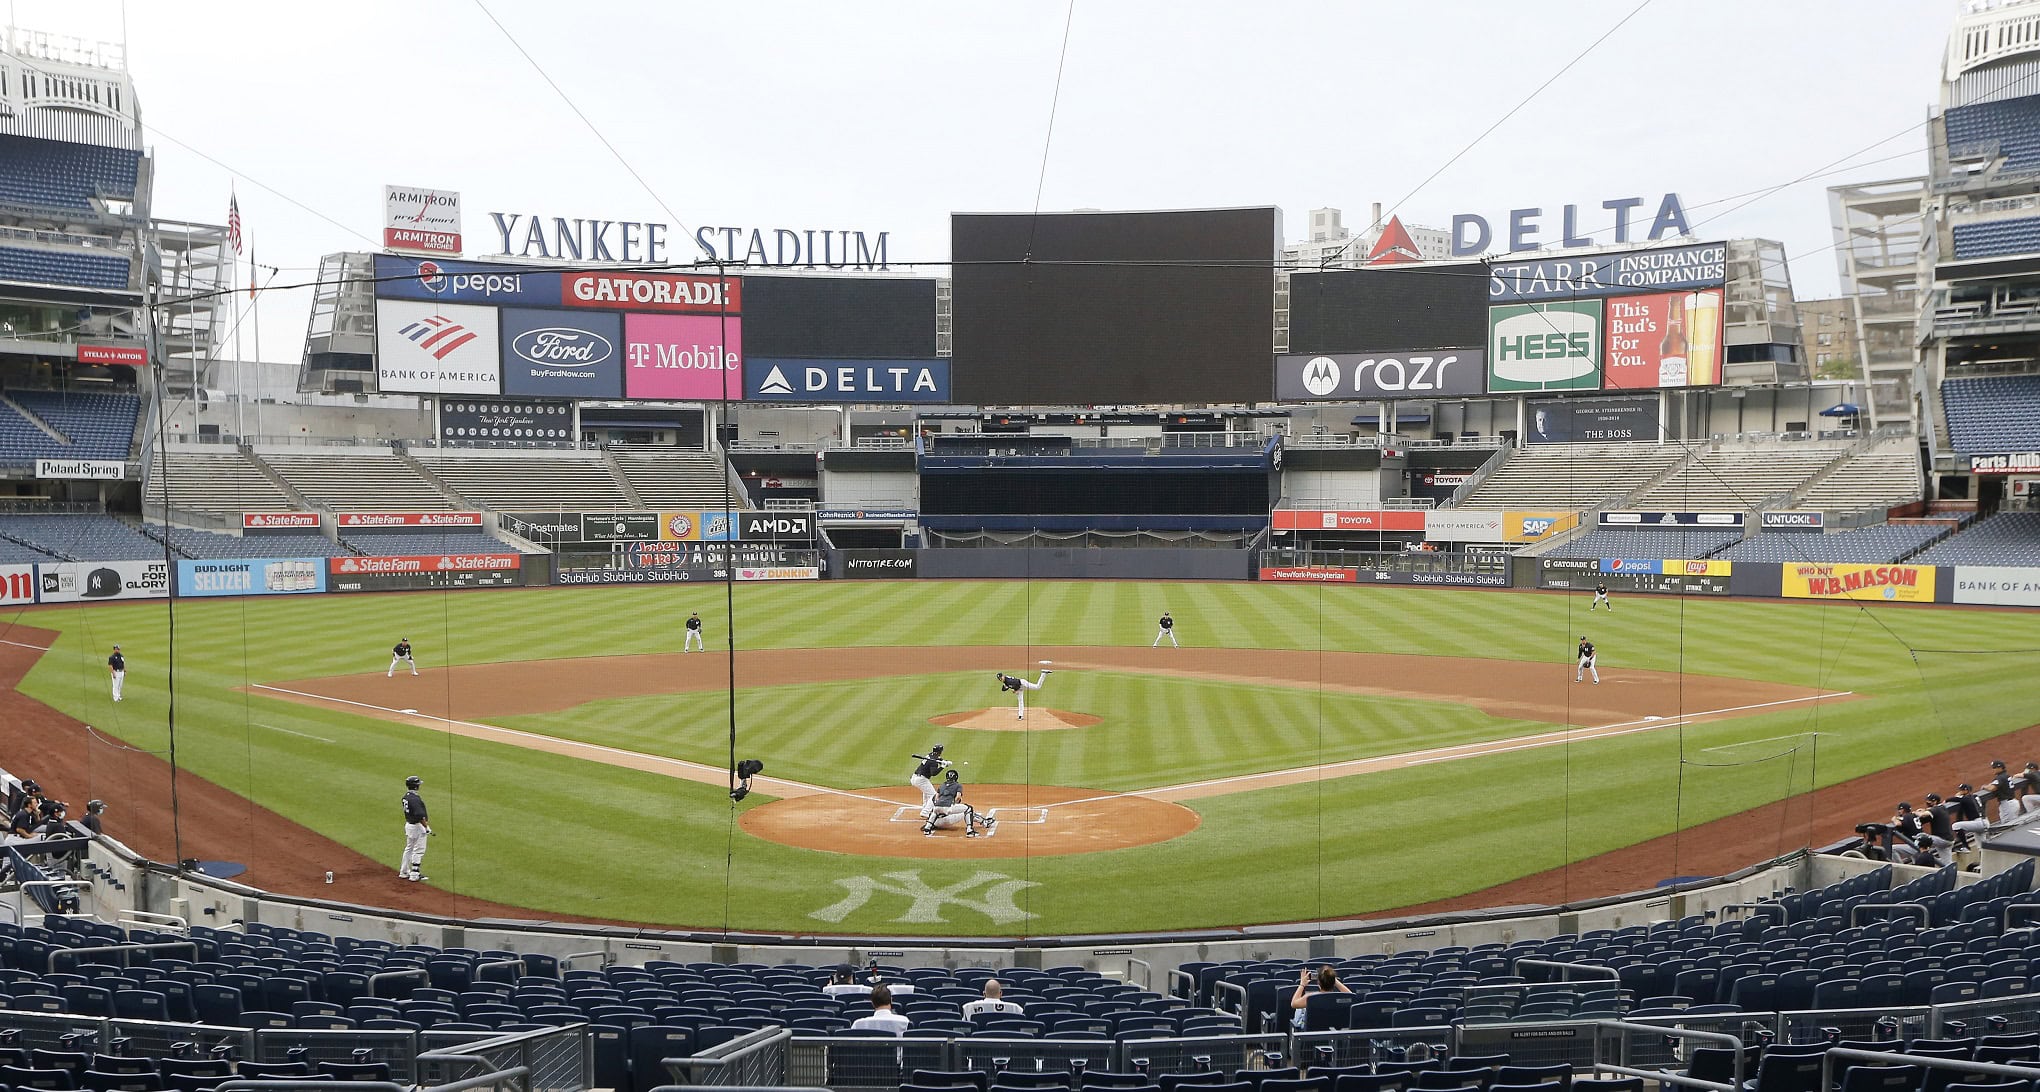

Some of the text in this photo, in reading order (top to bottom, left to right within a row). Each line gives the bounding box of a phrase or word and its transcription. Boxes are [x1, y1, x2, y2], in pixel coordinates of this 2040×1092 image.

[389, 191, 457, 207] ARMITRON
[1452, 193, 1691, 256] DELTA
[393, 230, 455, 244] ARMITRON
[489, 212, 890, 271] YANKEE STADIUM
[424, 242, 453, 250] WATCHES
[1618, 248, 1725, 272] INSURANCE
[1489, 260, 1607, 297] STARR
[1618, 264, 1725, 287] COMPANIES
[453, 274, 522, 297] pepsi
[573, 277, 730, 305] GATORADE
[1612, 301, 1649, 318] This
[1612, 317, 1657, 334] Bud's
[529, 331, 593, 362] Ford
[1499, 332, 1591, 361] HESS
[1612, 335, 1640, 351] For
[84, 351, 109, 359] STELLA
[654, 343, 739, 371] Mobile
[1610, 352, 1646, 367] You.
[381, 369, 496, 382] BANK OF AMERICA
[530, 368, 595, 380] BuyFordNow.com
[1354, 356, 1458, 391] razr
[805, 367, 938, 392] DELTA
[1585, 429, 1632, 439] THE BOSS
[1971, 455, 2007, 469] Parts
[42, 461, 119, 478] Poland Spring
[1339, 516, 1372, 524] TOYOTA
[1767, 514, 1810, 524] UNTUCKit
[530, 523, 578, 532] Postmates
[749, 519, 791, 533] AMD
[1523, 520, 1549, 534] SAP
[692, 544, 703, 563] A
[148, 564, 166, 572] FIT
[194, 564, 250, 573] BUD LIGHT
[848, 558, 913, 569] NITTOTIRE.COM
[1543, 560, 1551, 568] G
[1553, 560, 1588, 568] GATORADE
[1590, 560, 1598, 569] G
[1625, 561, 1651, 572] pepsi
[141, 572, 167, 580] FOR
[647, 571, 689, 581] StubHub
[713, 570, 726, 578] 399
[767, 568, 812, 578] DUNKIN'
[1375, 572, 1387, 580] 385
[1797, 567, 1833, 575] WHO BUT
[194, 573, 251, 591] SELTZER
[560, 573, 599, 584] StubHub
[603, 572, 644, 583] StubHub
[1412, 574, 1443, 582] StubHub
[1445, 575, 1474, 583] StubHub
[1476, 576, 1505, 584] StubHub
[126, 580, 166, 589] GLORY
[1959, 581, 1997, 590] BANK
[2001, 582, 2020, 591] OF
